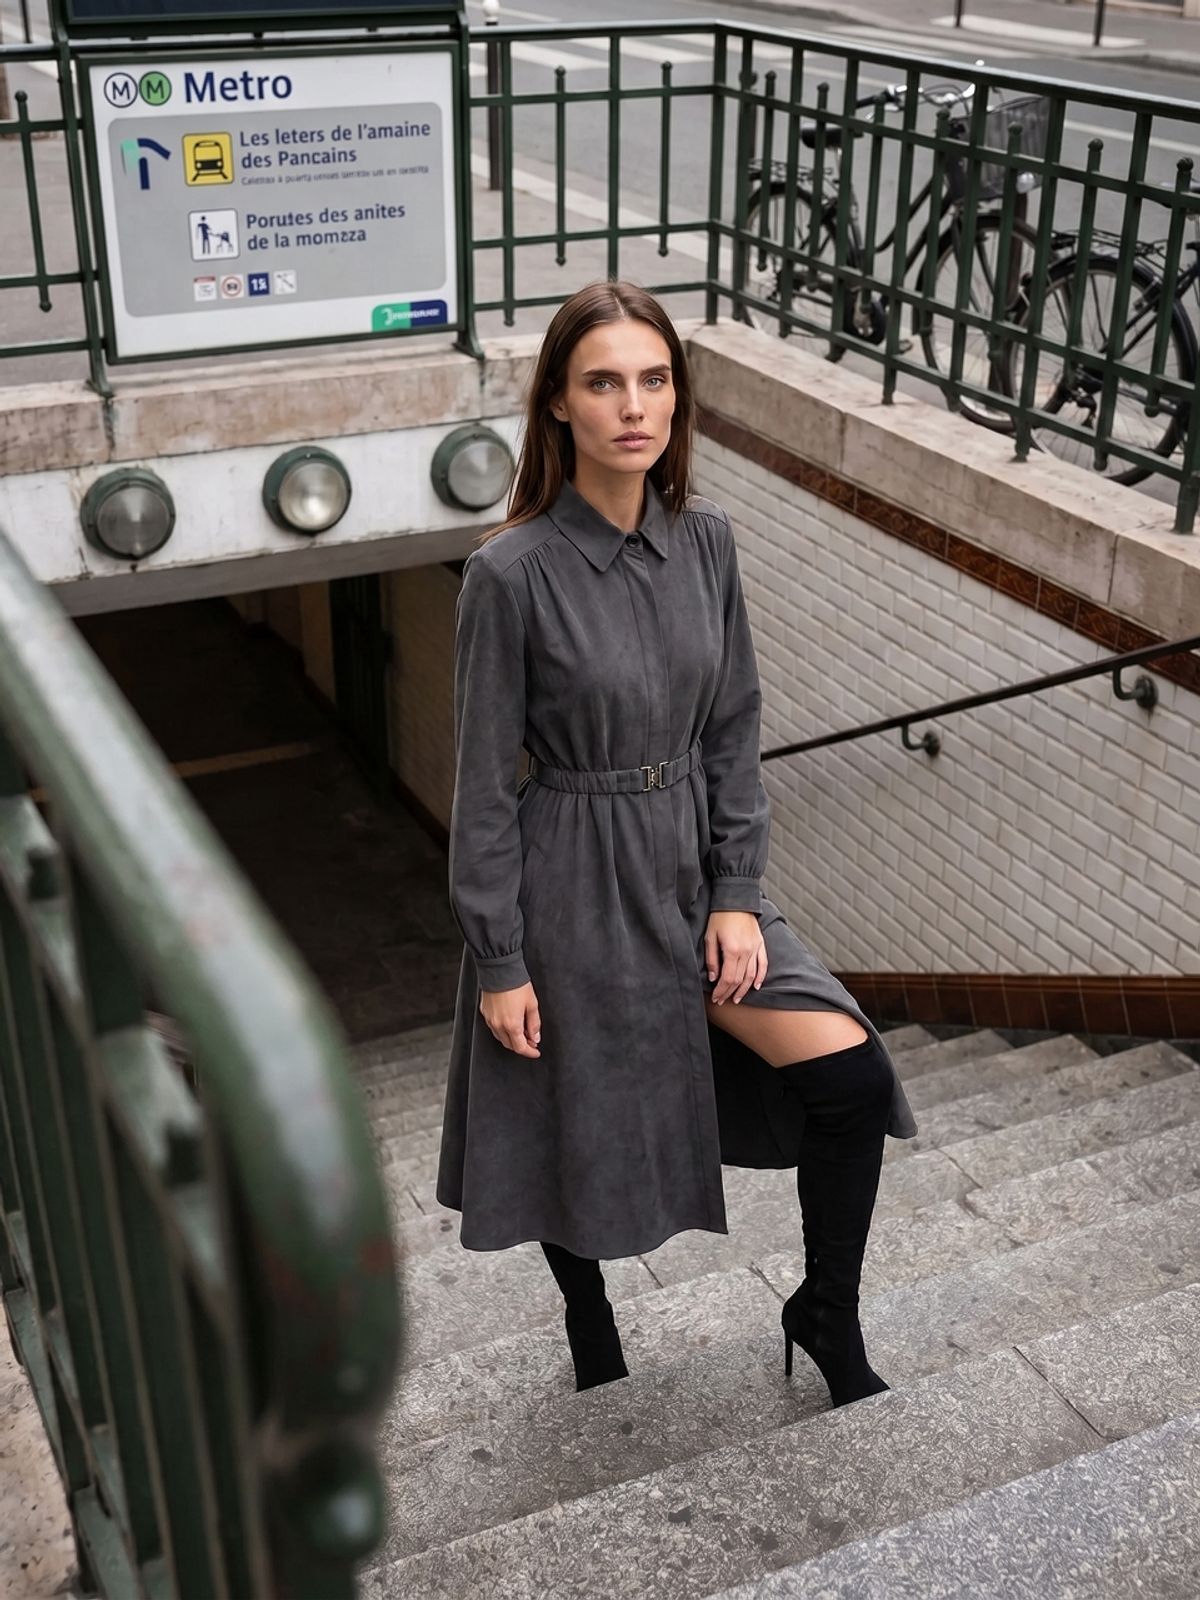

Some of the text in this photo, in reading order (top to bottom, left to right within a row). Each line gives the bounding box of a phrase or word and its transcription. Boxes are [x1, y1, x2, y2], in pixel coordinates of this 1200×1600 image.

[112, 71, 292, 103] M M Metro
[240, 131, 270, 147] Les
[275, 128, 325, 145] leters
[331, 125, 352, 142] de
[241, 147, 357, 169] des Pancains
[319, 208, 348, 224] des
[354, 203, 405, 221] anites
[247, 235, 269, 251] de
[275, 233, 290, 248] la
